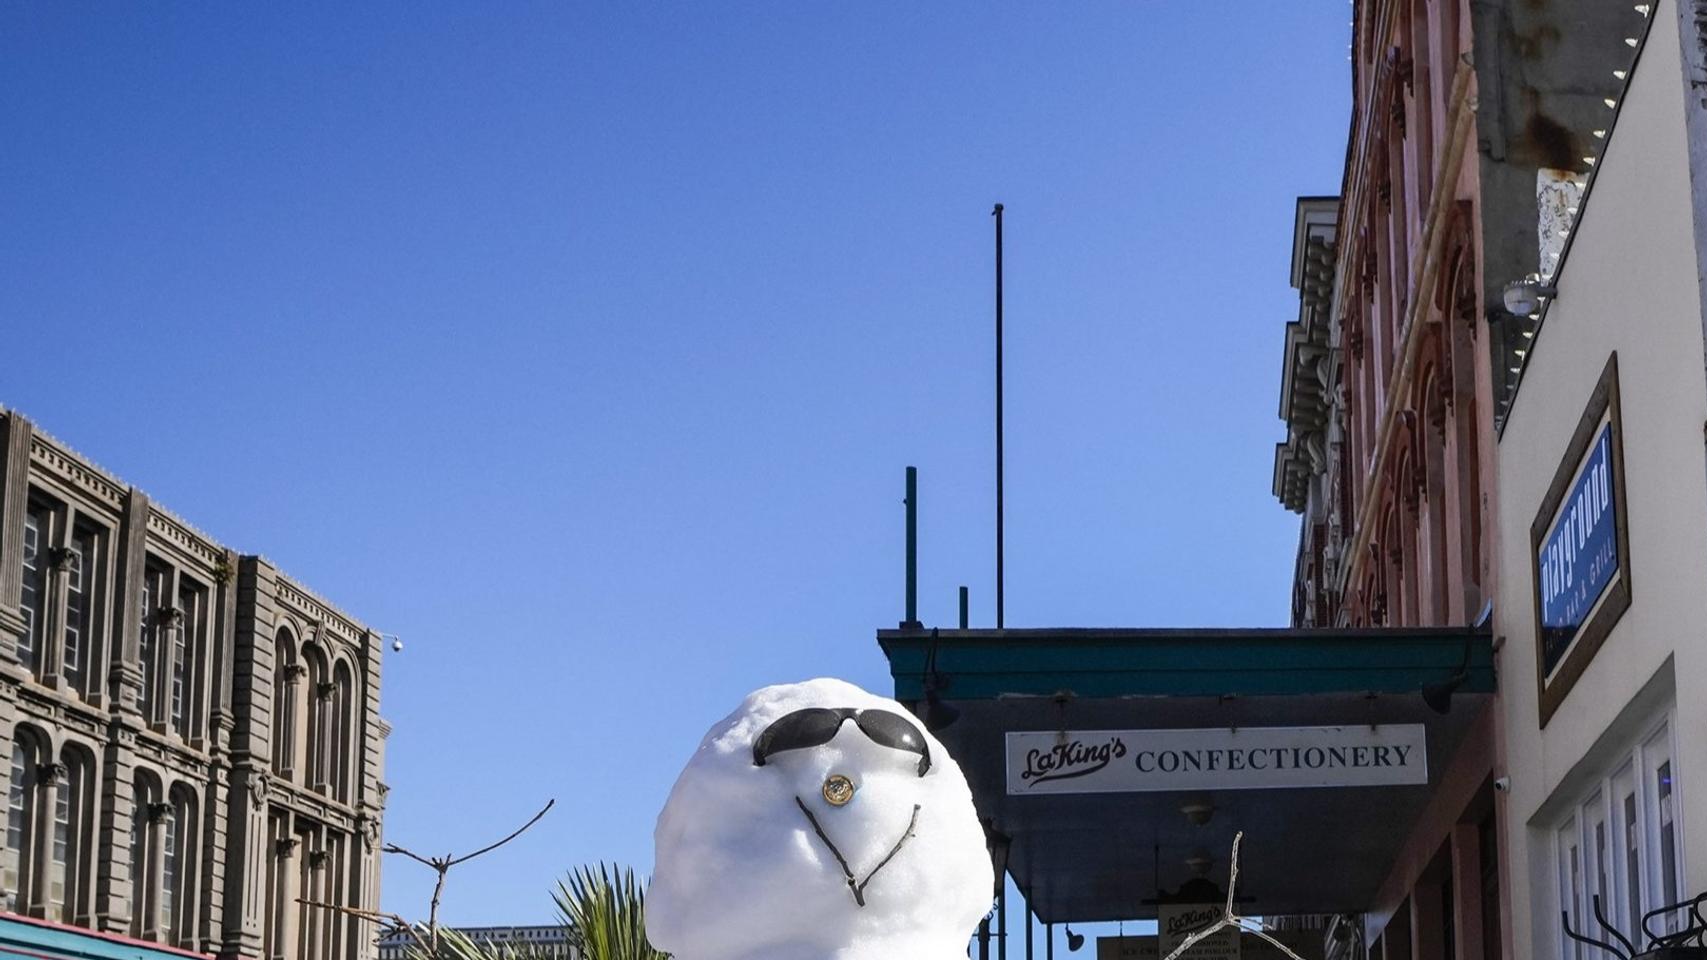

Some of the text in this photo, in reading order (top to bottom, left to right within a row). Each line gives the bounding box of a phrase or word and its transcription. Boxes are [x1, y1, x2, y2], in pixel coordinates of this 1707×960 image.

[1543, 438, 1608, 622] playground
[1590, 536, 1613, 586] GRILL
[1021, 736, 1412, 788] LaKing's CONFECTIONERY
